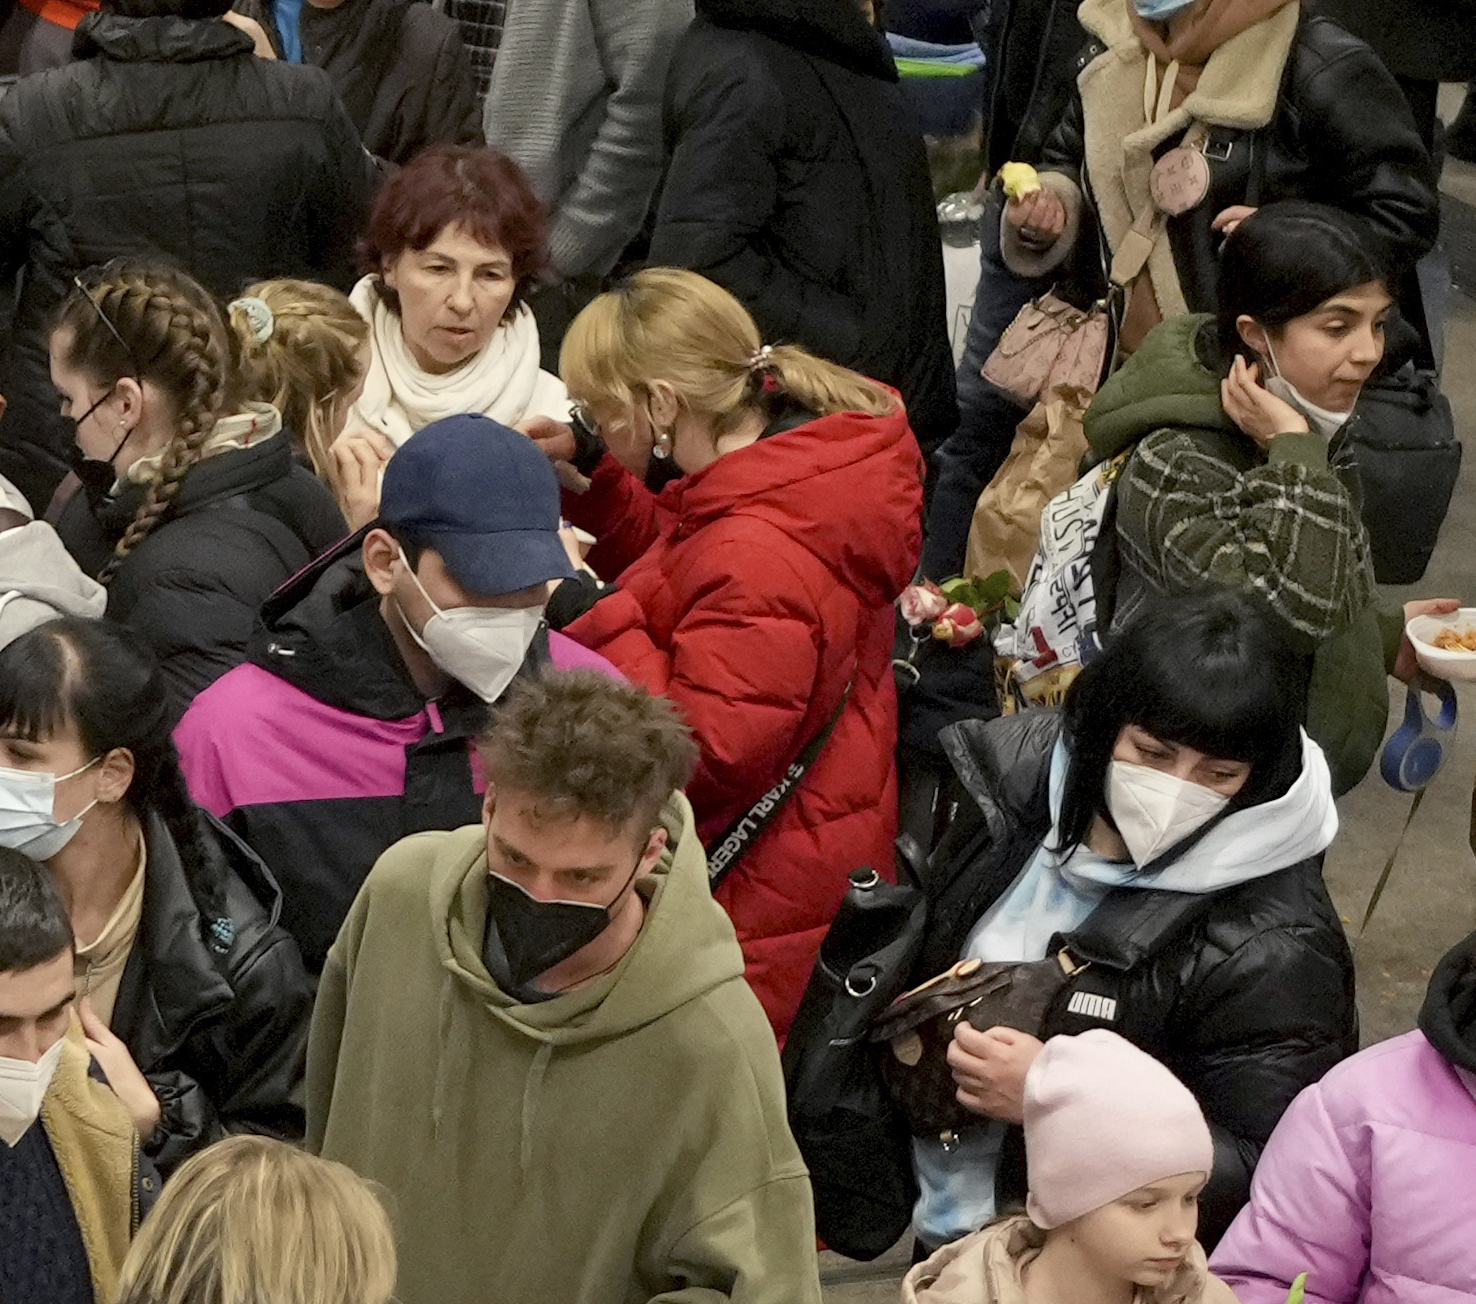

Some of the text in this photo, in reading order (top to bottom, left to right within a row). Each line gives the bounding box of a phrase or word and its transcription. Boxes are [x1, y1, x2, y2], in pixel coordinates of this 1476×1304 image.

[707, 778, 792, 880] KARL LAGER
[1066, 990, 1117, 1022] UMA
